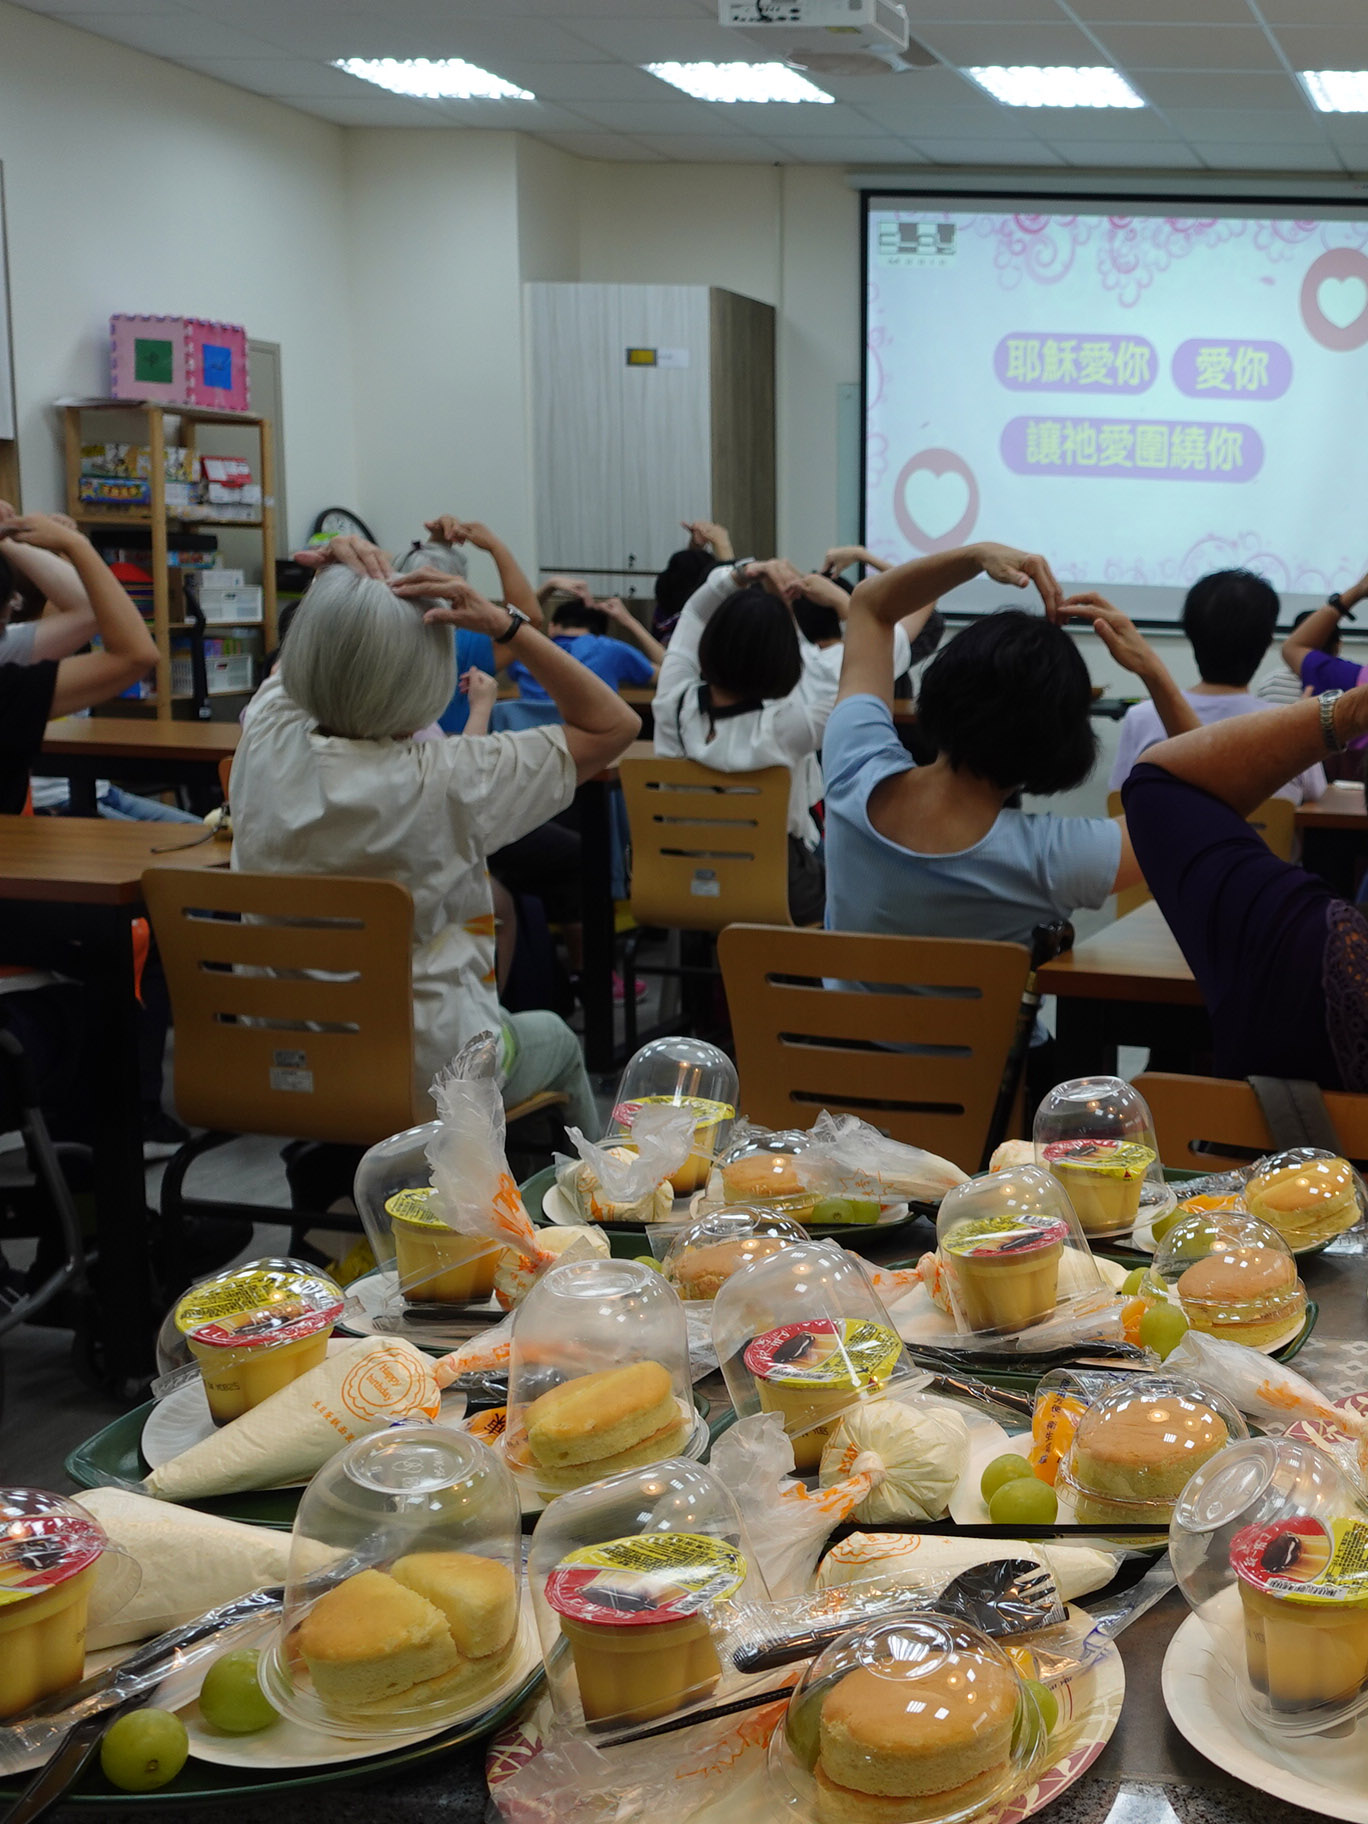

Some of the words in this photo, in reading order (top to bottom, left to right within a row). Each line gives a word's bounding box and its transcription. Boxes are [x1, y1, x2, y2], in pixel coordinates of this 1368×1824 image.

[1006, 339, 1151, 386] 耶穌愛你
[1195, 346, 1269, 391] 愛你
[1025, 420, 1244, 471] 讓祂愛圍繞你
[366, 1373, 394, 1402] birthday
[379, 1364, 401, 1386] Happy
